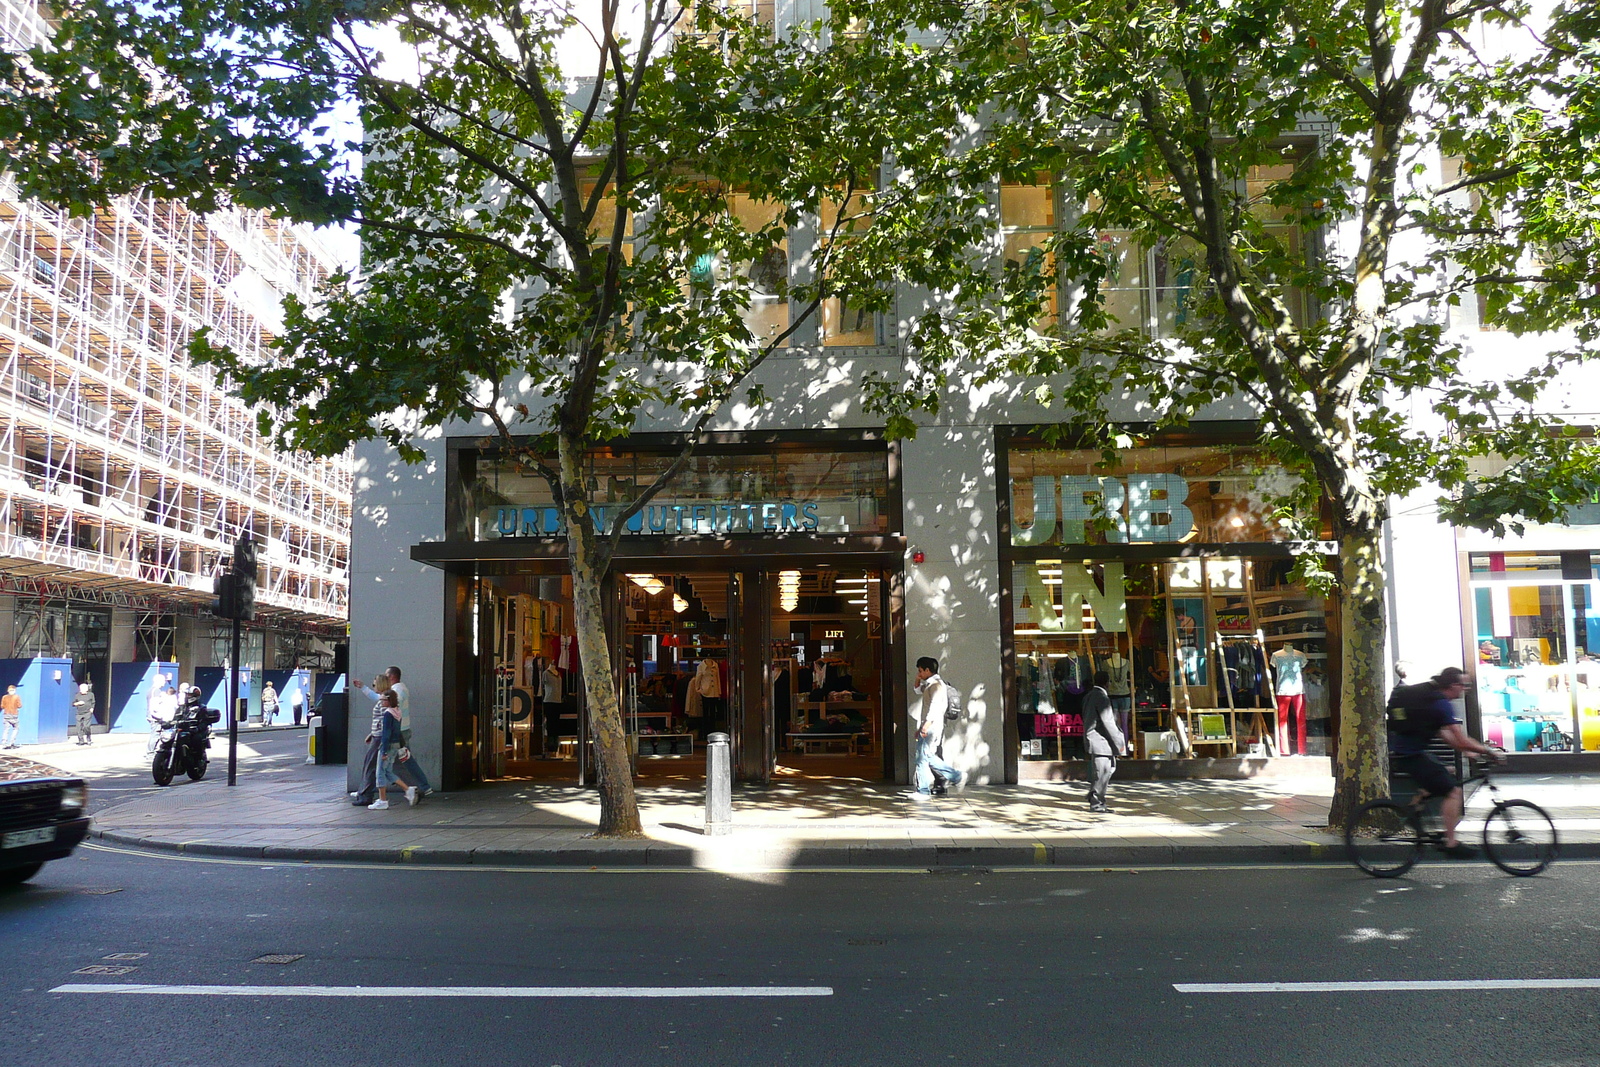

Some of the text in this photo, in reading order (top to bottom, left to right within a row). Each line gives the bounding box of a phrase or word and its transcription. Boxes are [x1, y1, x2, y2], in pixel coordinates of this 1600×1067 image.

[498, 503, 819, 534] URBN OUTFITTERS
[1010, 473, 1194, 545] URB
[1012, 562, 1126, 632] AN
[825, 630, 844, 638] LIFT
[1041, 714, 1084, 726] URBA
